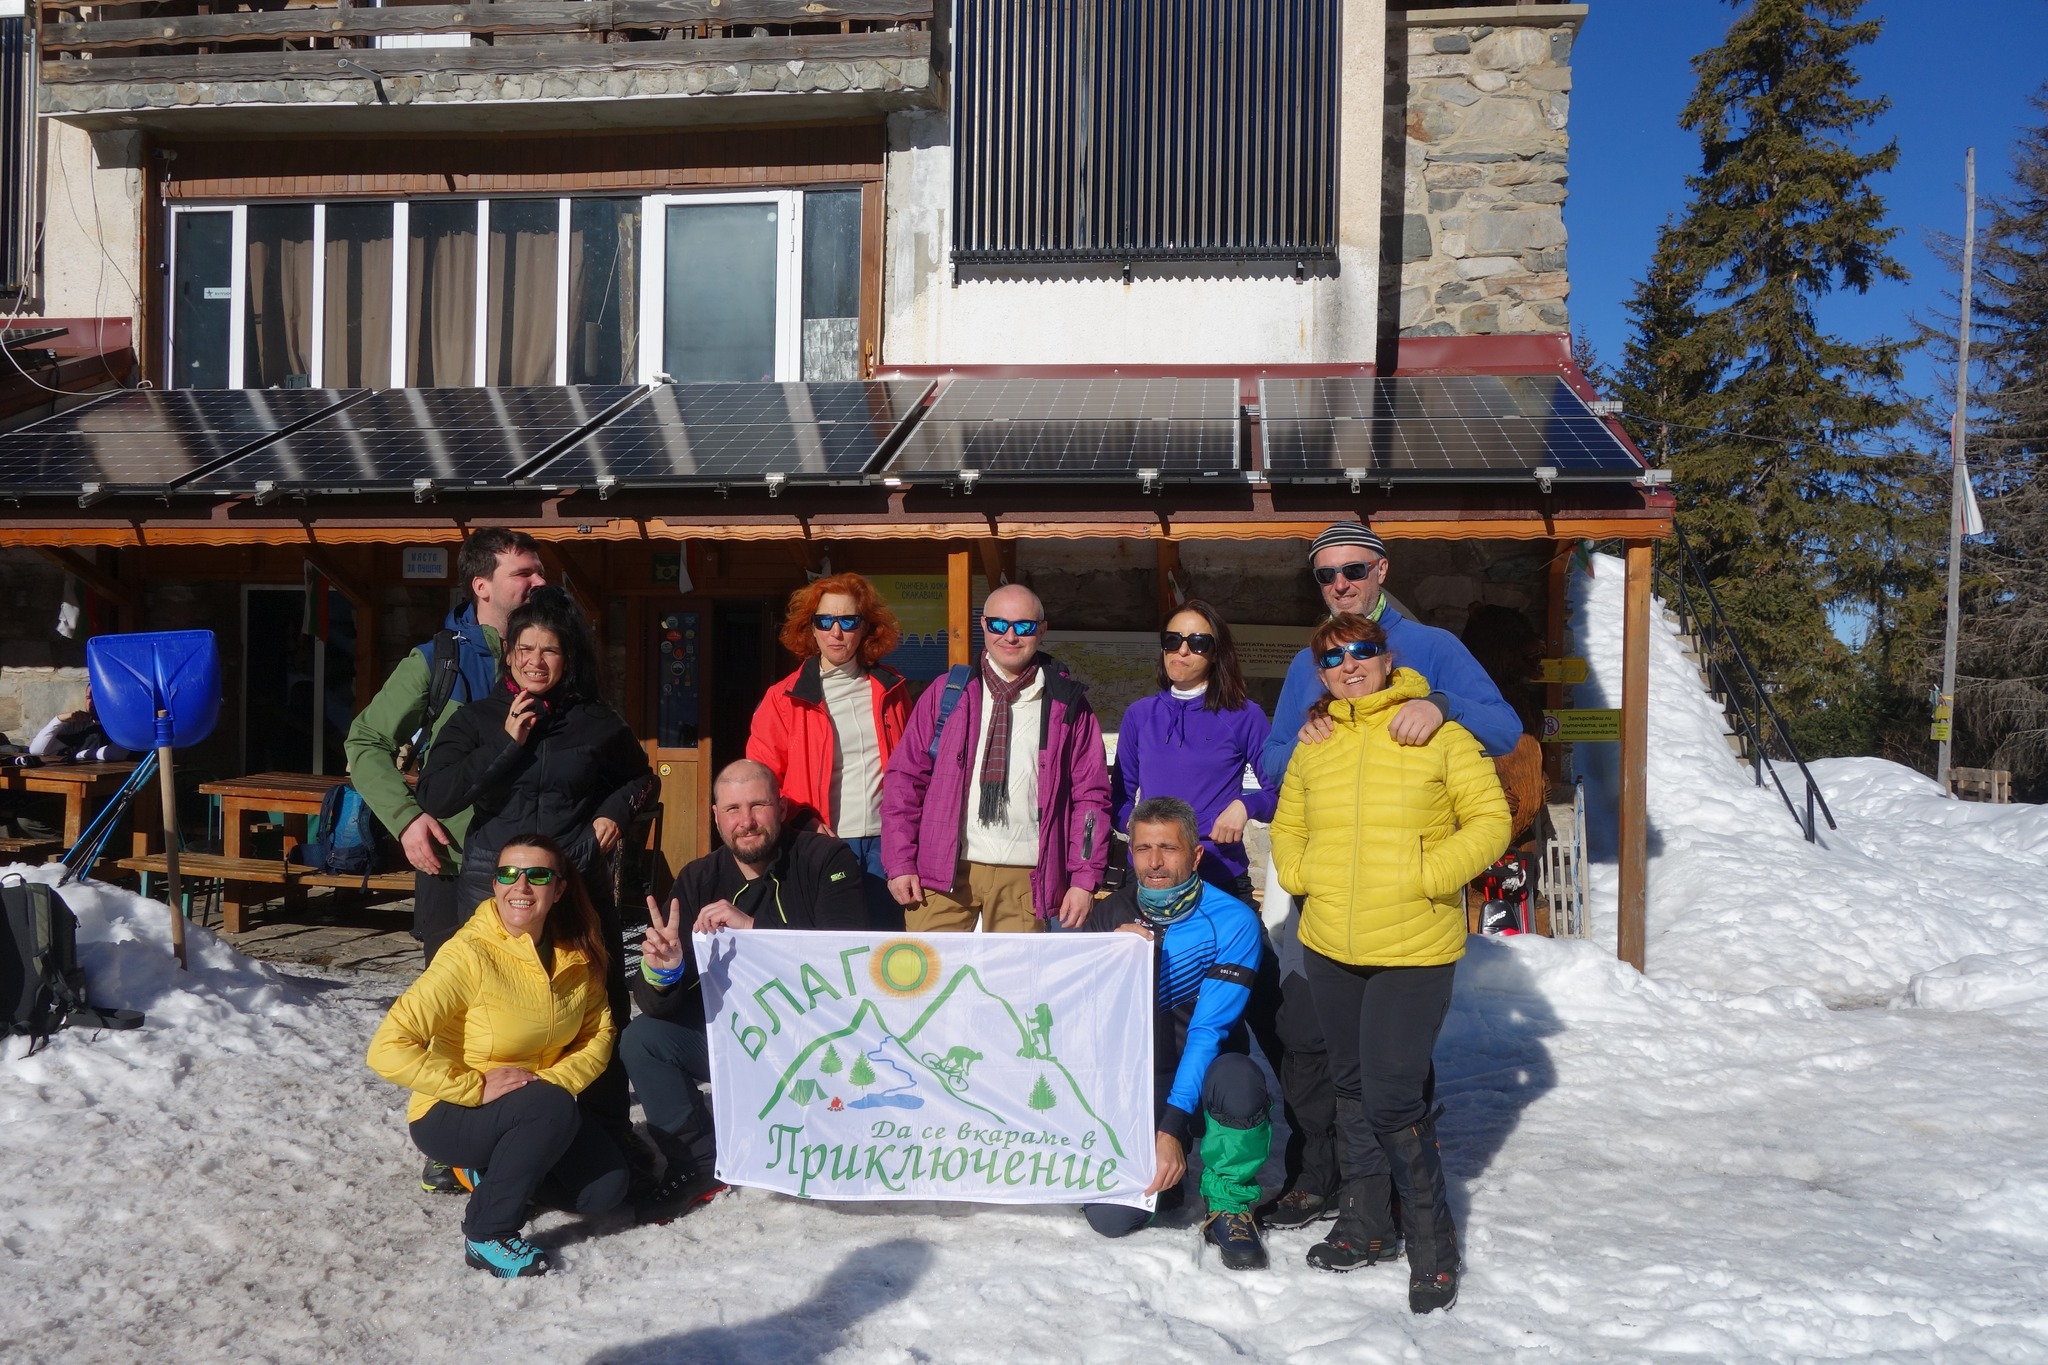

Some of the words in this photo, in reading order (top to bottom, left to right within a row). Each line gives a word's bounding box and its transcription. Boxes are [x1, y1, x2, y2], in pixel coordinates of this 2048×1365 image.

[411, 552, 437, 562] МЯСТО
[407, 564, 415, 573] ЗА
[417, 564, 442, 573] ПУШЕНЕ
[901, 591, 943, 600] СКАКАВИЦА
[870, 1119, 911, 1140] Да
[921, 1125, 947, 1140] се
[957, 1120, 1072, 1150] вкараме
[1080, 1129, 1097, 1150] в
[765, 1121, 1121, 1199] Приключение
